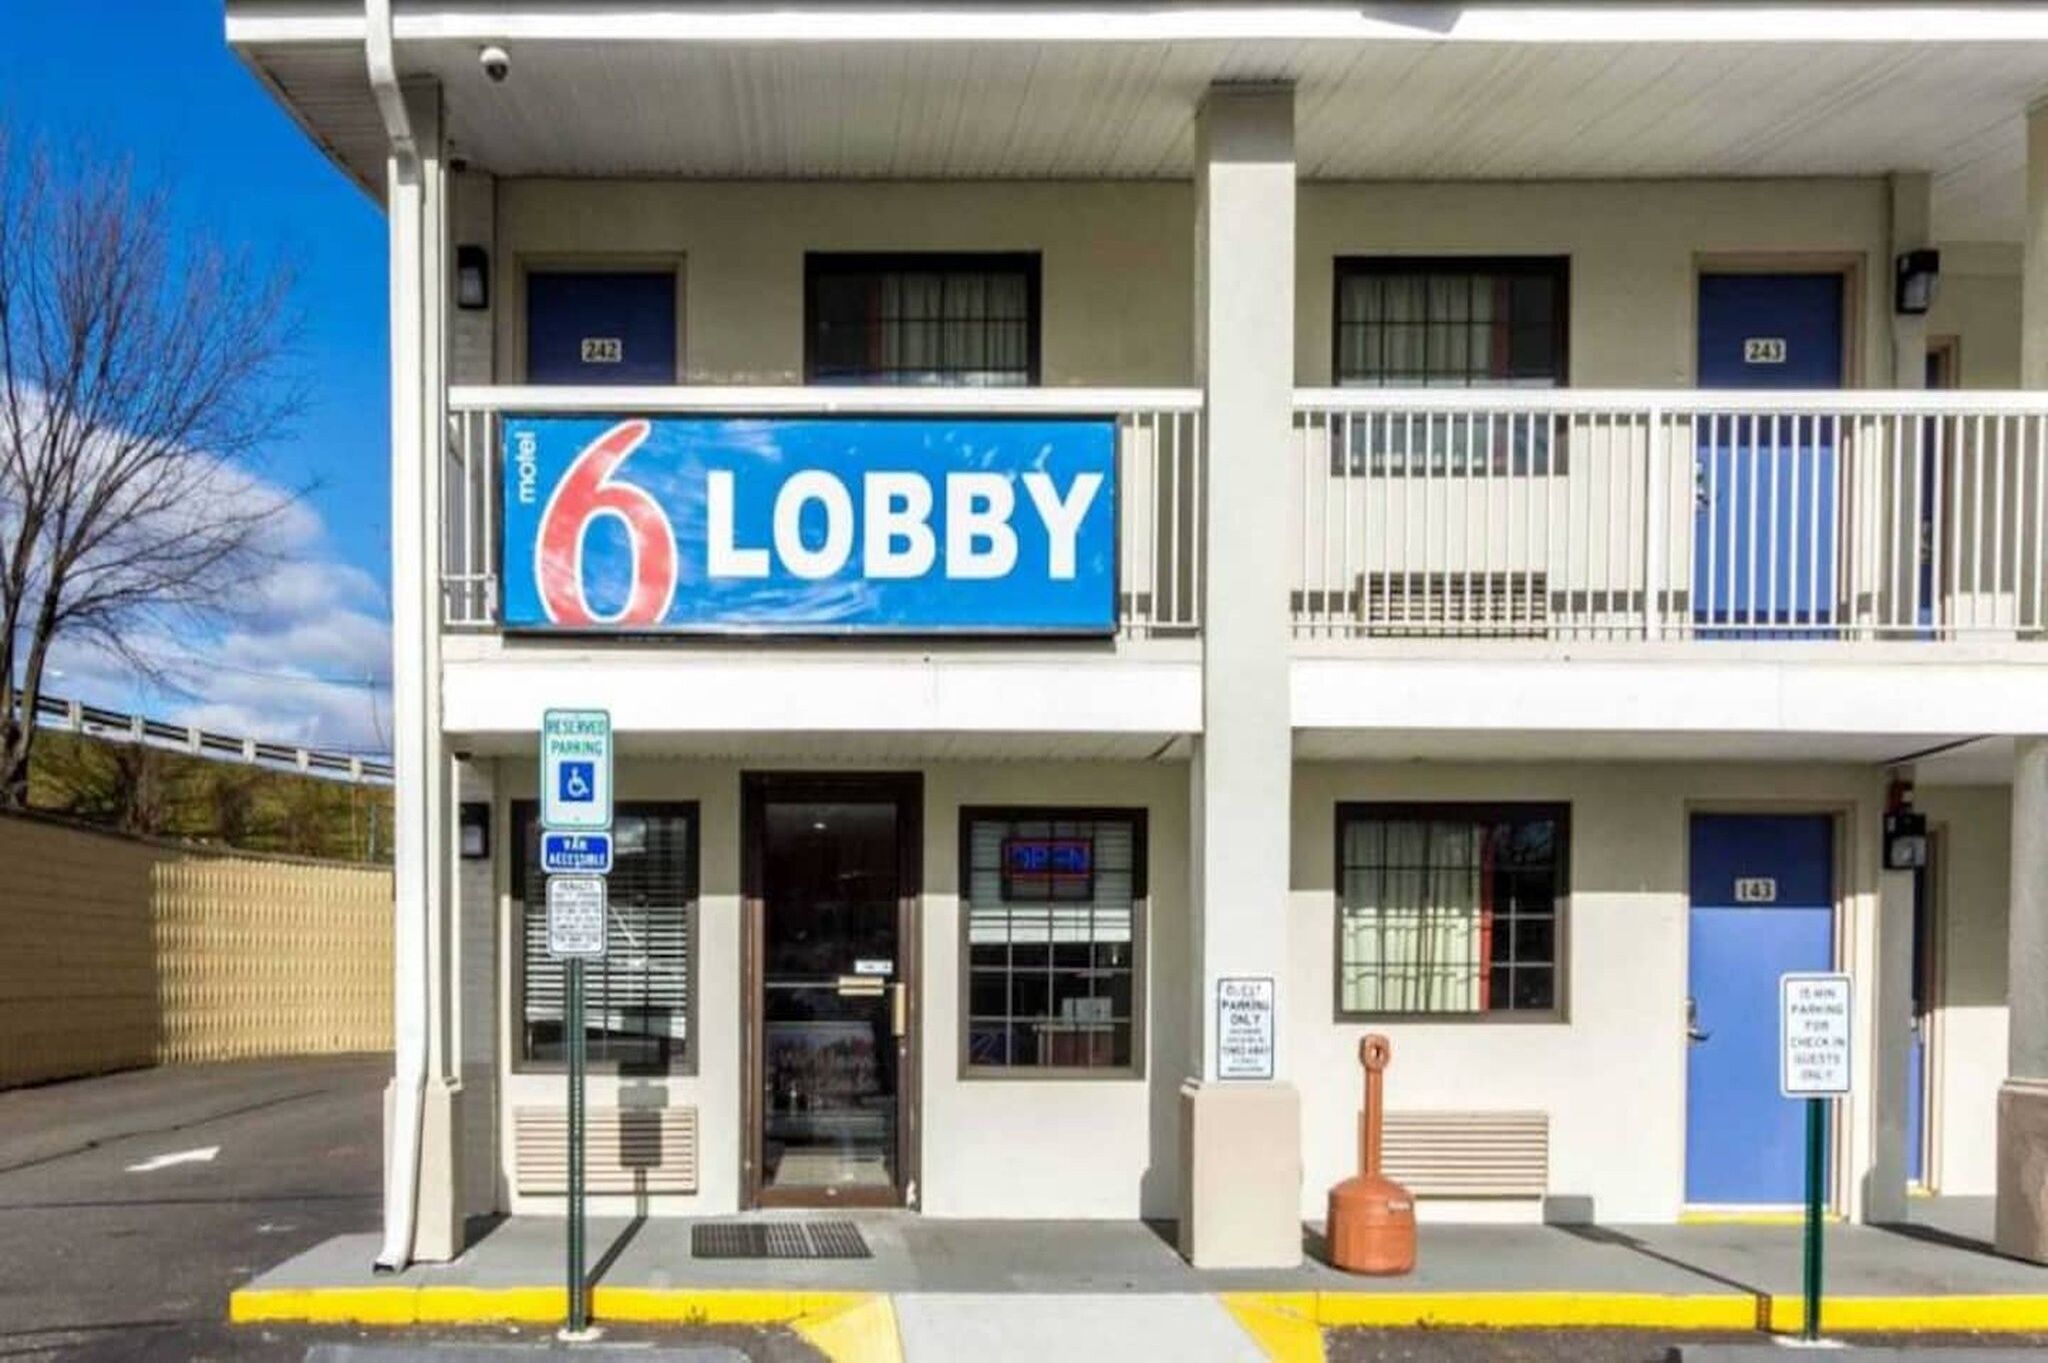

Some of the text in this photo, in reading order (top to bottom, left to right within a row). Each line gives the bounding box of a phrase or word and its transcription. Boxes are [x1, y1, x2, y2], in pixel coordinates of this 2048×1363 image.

[586, 342, 617, 359] 242
[1750, 342, 1782, 360] 243
[514, 431, 537, 503] motel
[534, 419, 678, 626] 6
[706, 470, 1104, 579] LOBBY
[547, 719, 605, 735] RESERVED
[551, 739, 603, 756] PARKING
[563, 836, 589, 851] VAN
[548, 852, 606, 866] ACCESSIBLE
[1741, 882, 1771, 899] 143
[1222, 1001, 1270, 1011] PARKING
[1791, 1003, 1844, 1015] PARKING
[1230, 1013, 1260, 1026] ONLY
[1805, 1021, 1829, 1032] FOR
[1795, 1053, 1841, 1065] GUESTS
[1802, 1069, 1833, 1080] ONLY
